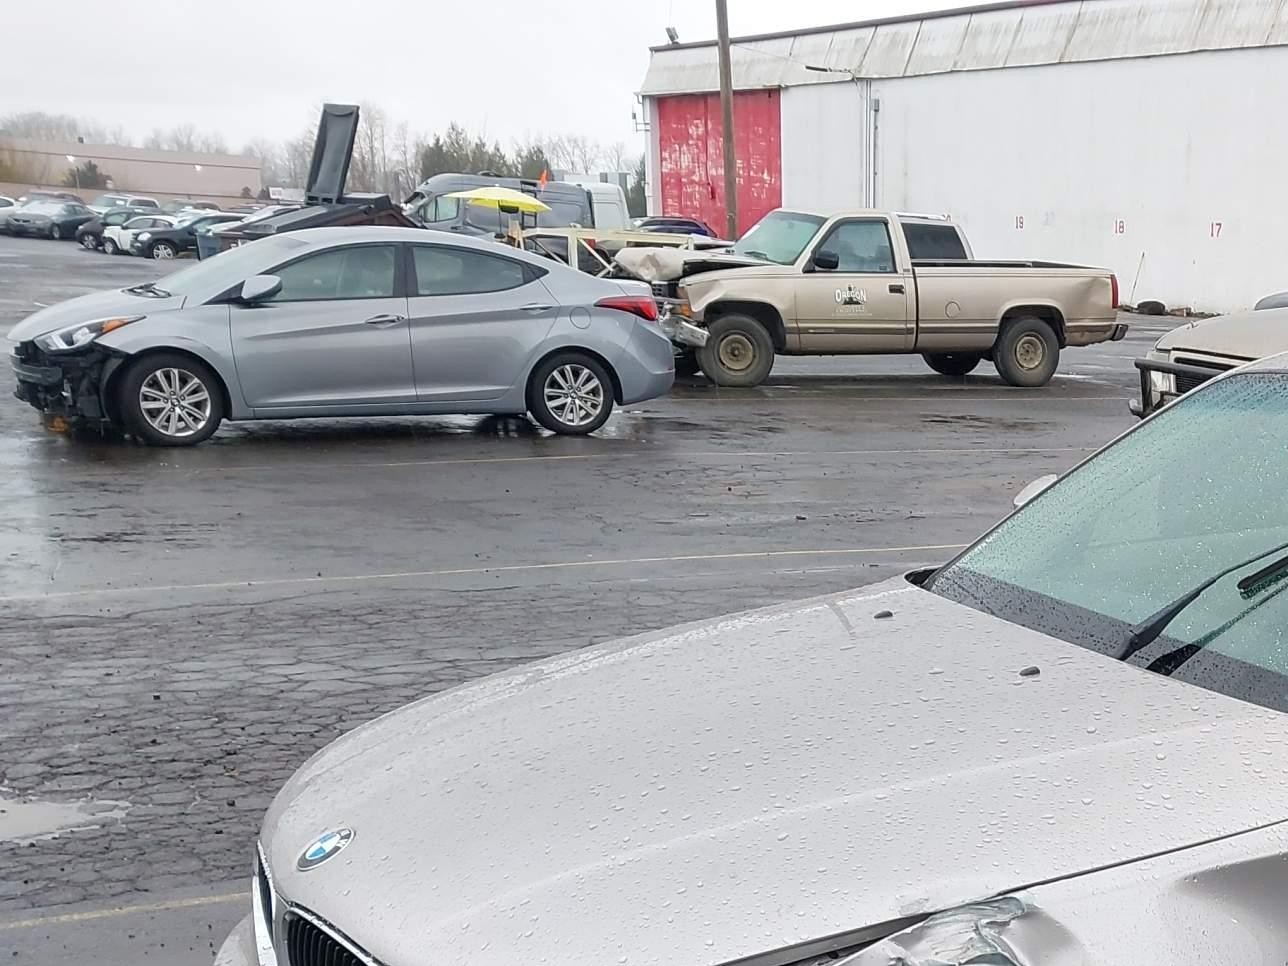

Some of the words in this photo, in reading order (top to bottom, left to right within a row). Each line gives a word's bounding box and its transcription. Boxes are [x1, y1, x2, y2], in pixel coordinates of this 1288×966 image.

[1015, 215, 1024, 229] 19
[1114, 219, 1125, 234] 18
[1210, 221, 1223, 238] 17
